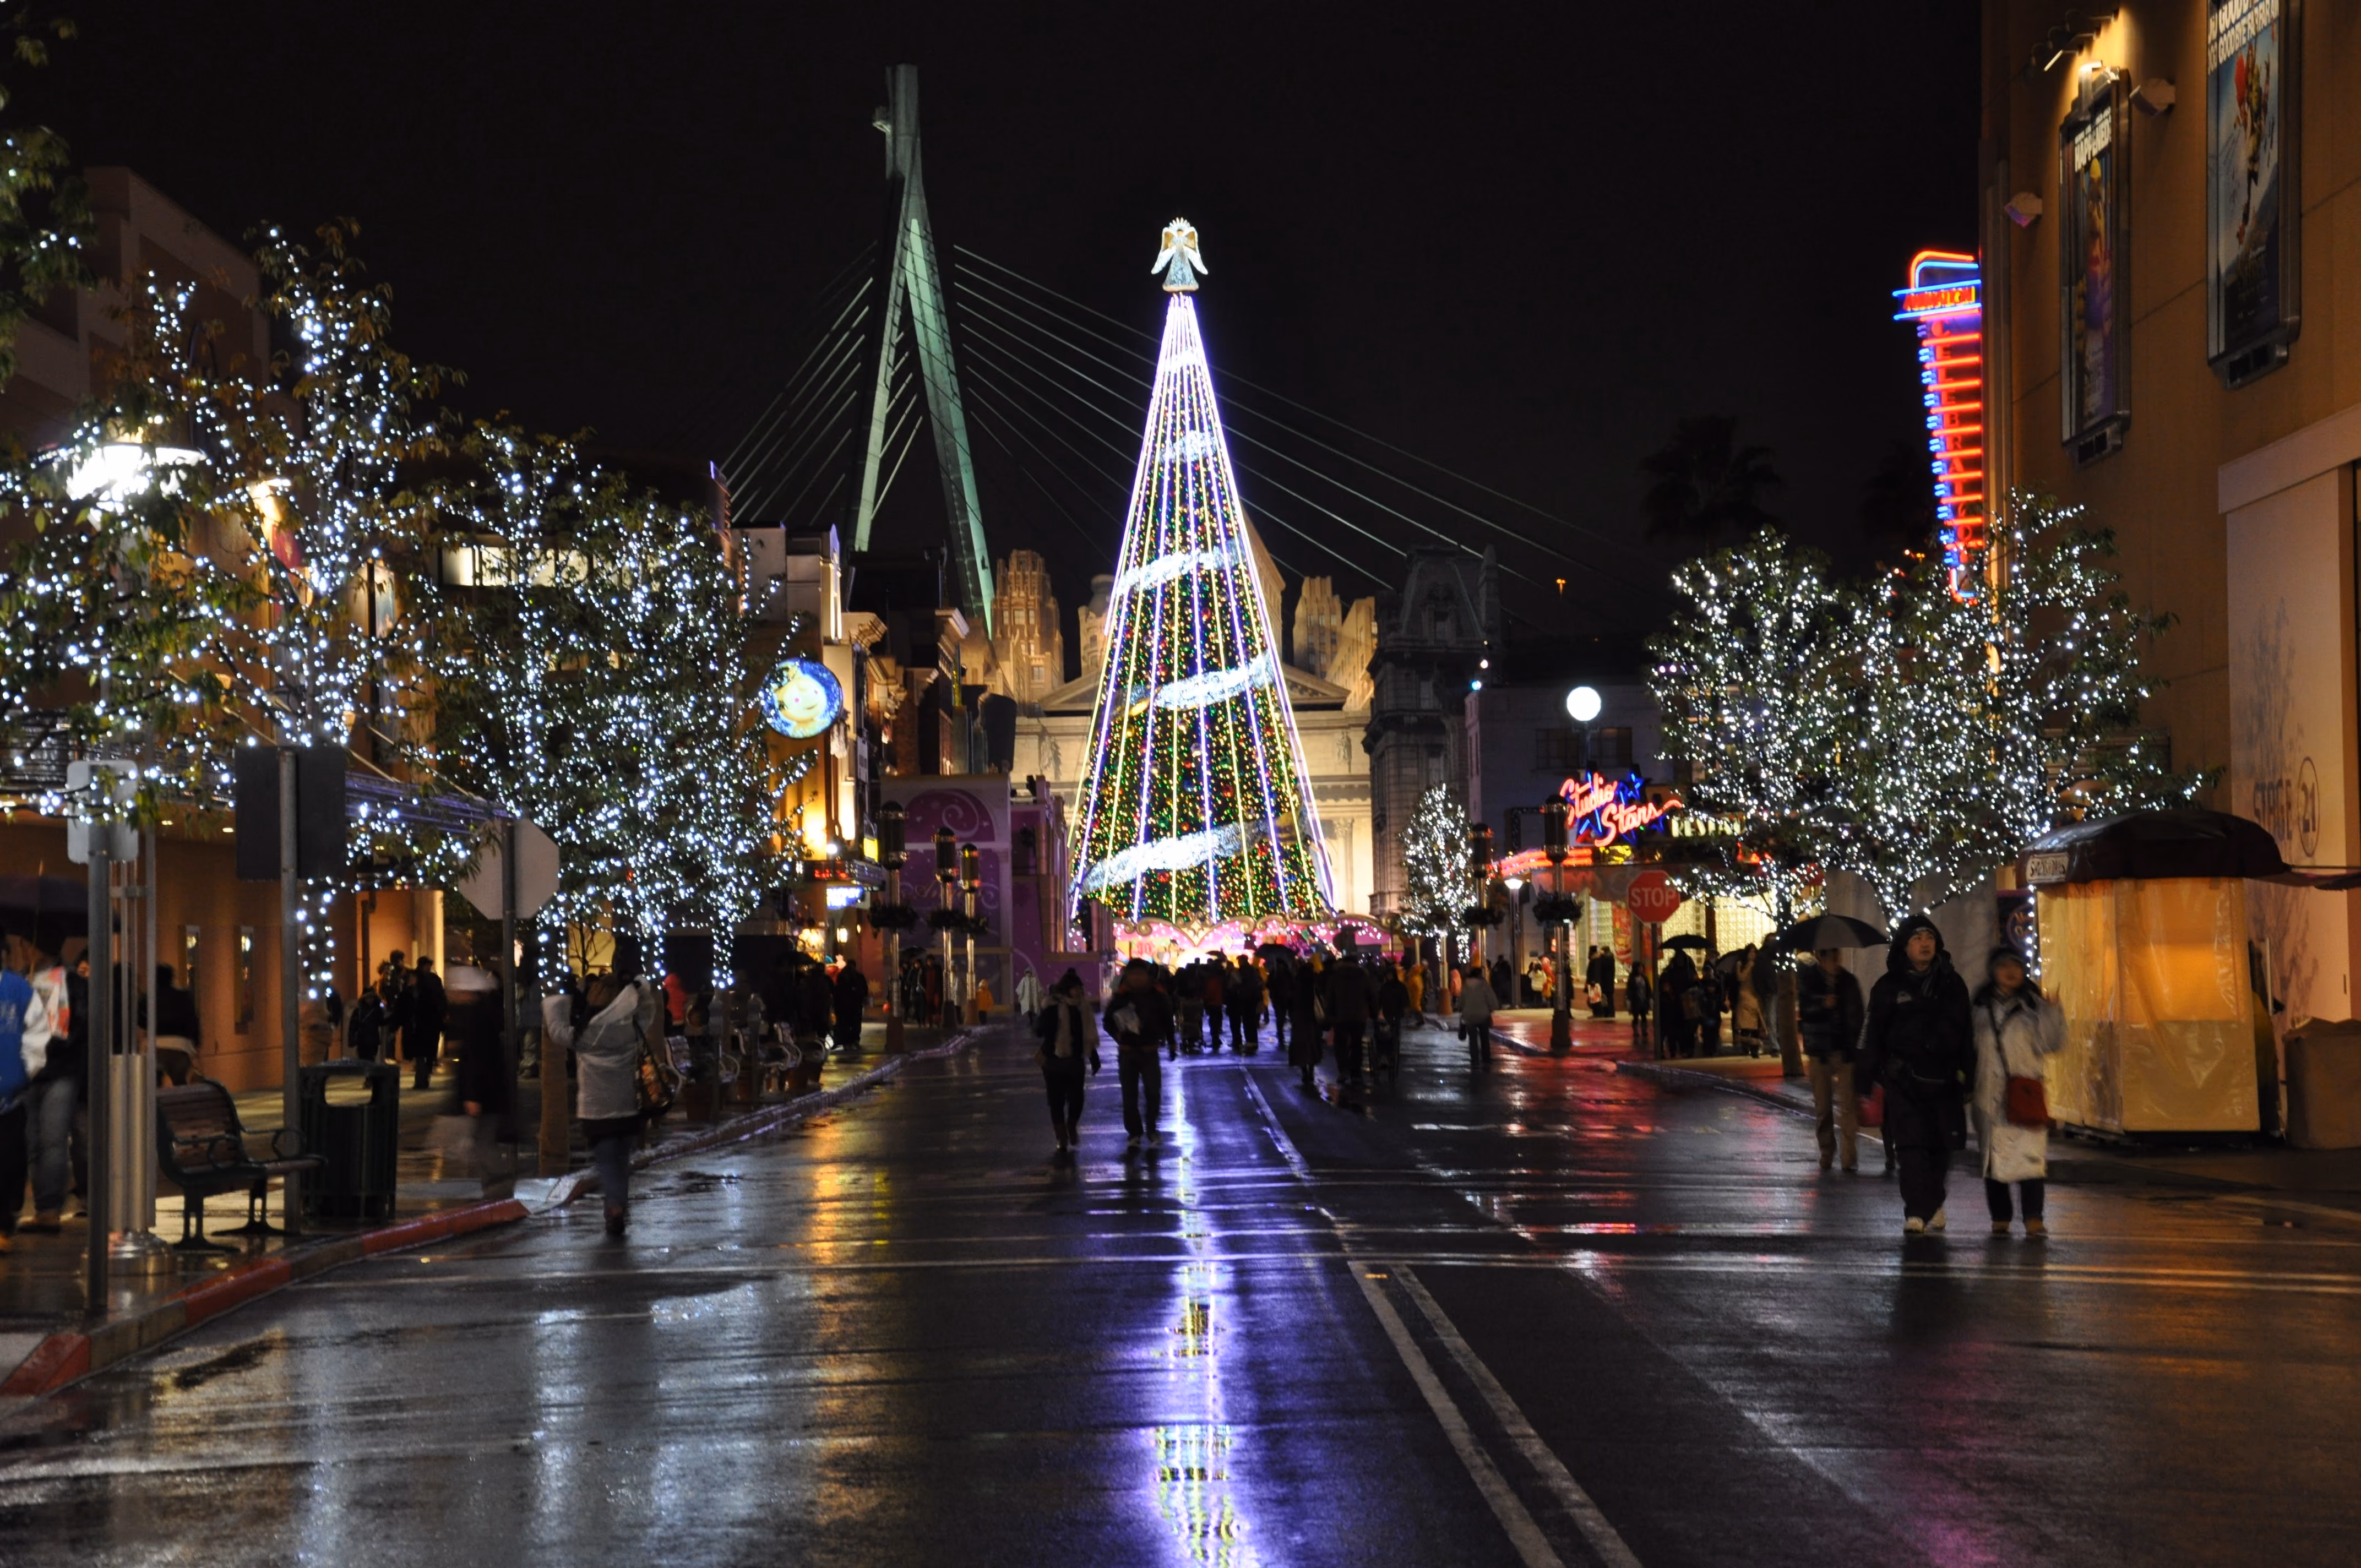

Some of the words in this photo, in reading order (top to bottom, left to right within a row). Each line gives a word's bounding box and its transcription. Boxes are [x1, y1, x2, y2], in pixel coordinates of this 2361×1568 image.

[1559, 772, 1618, 827] Studio
[1595, 800, 1680, 847] Stars
[2254, 777, 2292, 840] STAGE
[2301, 782, 2316, 833] 21
[1631, 887, 1677, 908] STOP
